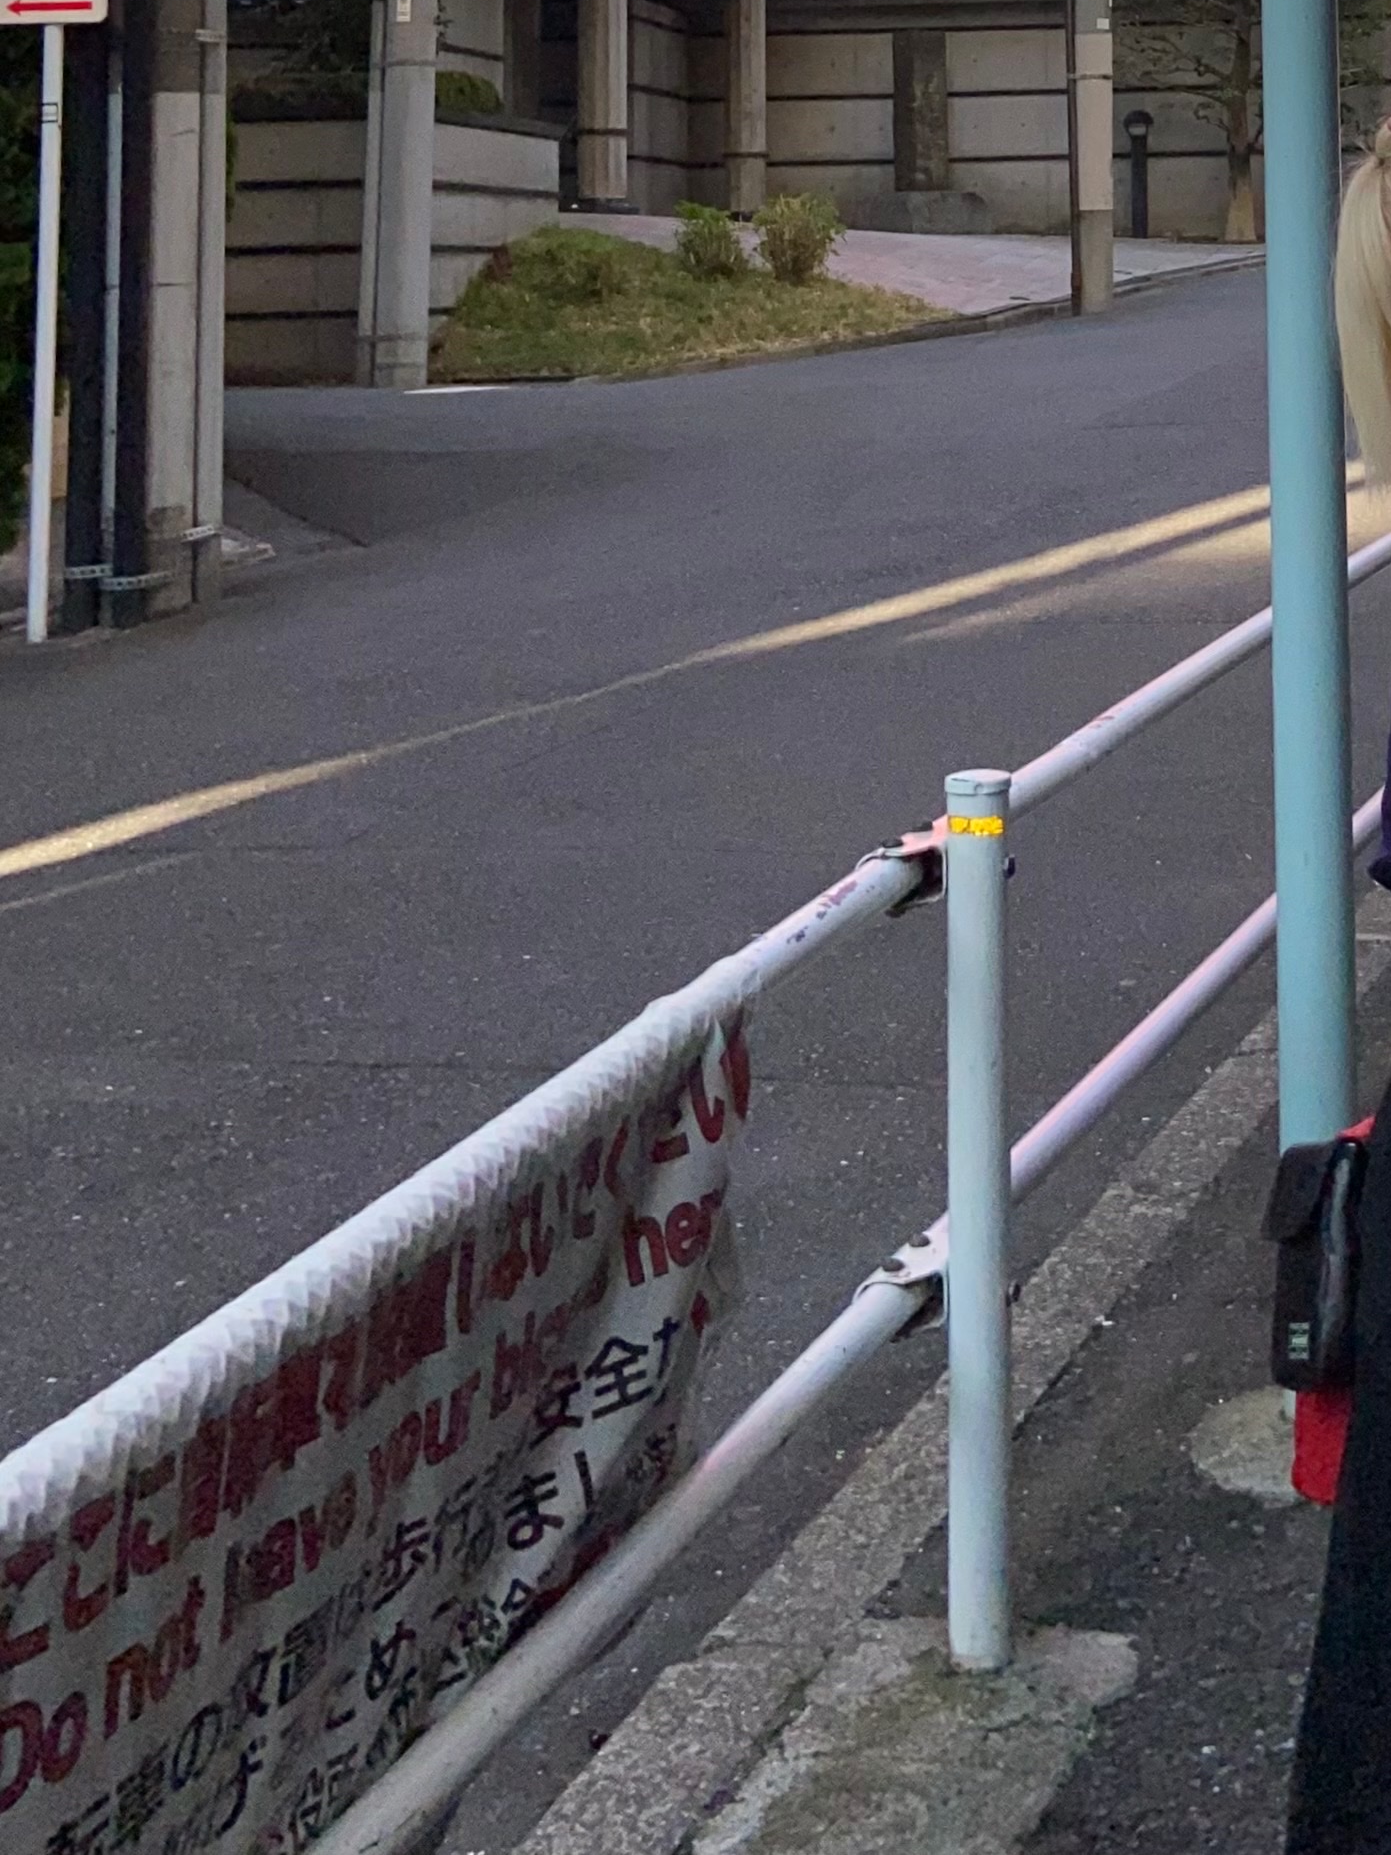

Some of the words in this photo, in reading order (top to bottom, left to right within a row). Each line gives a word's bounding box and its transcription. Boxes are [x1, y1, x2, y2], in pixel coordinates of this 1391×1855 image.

[0, 1700, 88, 1814] Do
[104, 1577, 205, 1741] not
[217, 1471, 357, 1645] leave
[364, 1369, 481, 1541] your
[622, 1189, 722, 1287] her
